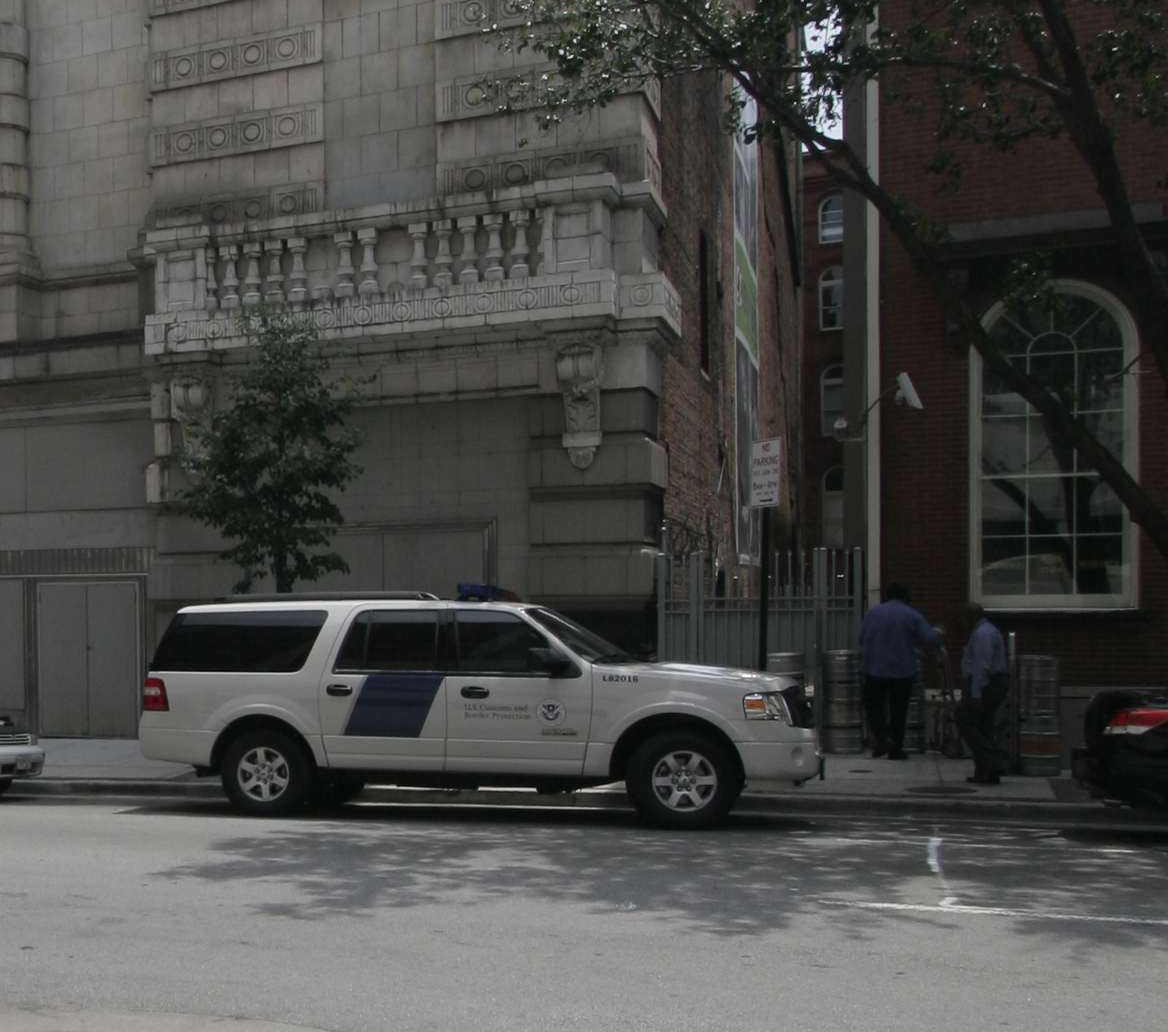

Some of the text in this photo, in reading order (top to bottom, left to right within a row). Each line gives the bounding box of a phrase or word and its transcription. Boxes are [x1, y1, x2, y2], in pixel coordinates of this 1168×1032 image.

[753, 454, 779, 466] PARKING
[479, 703, 512, 712] Customs
[514, 704, 528, 712] and
[464, 712, 532, 720] Border Protection
